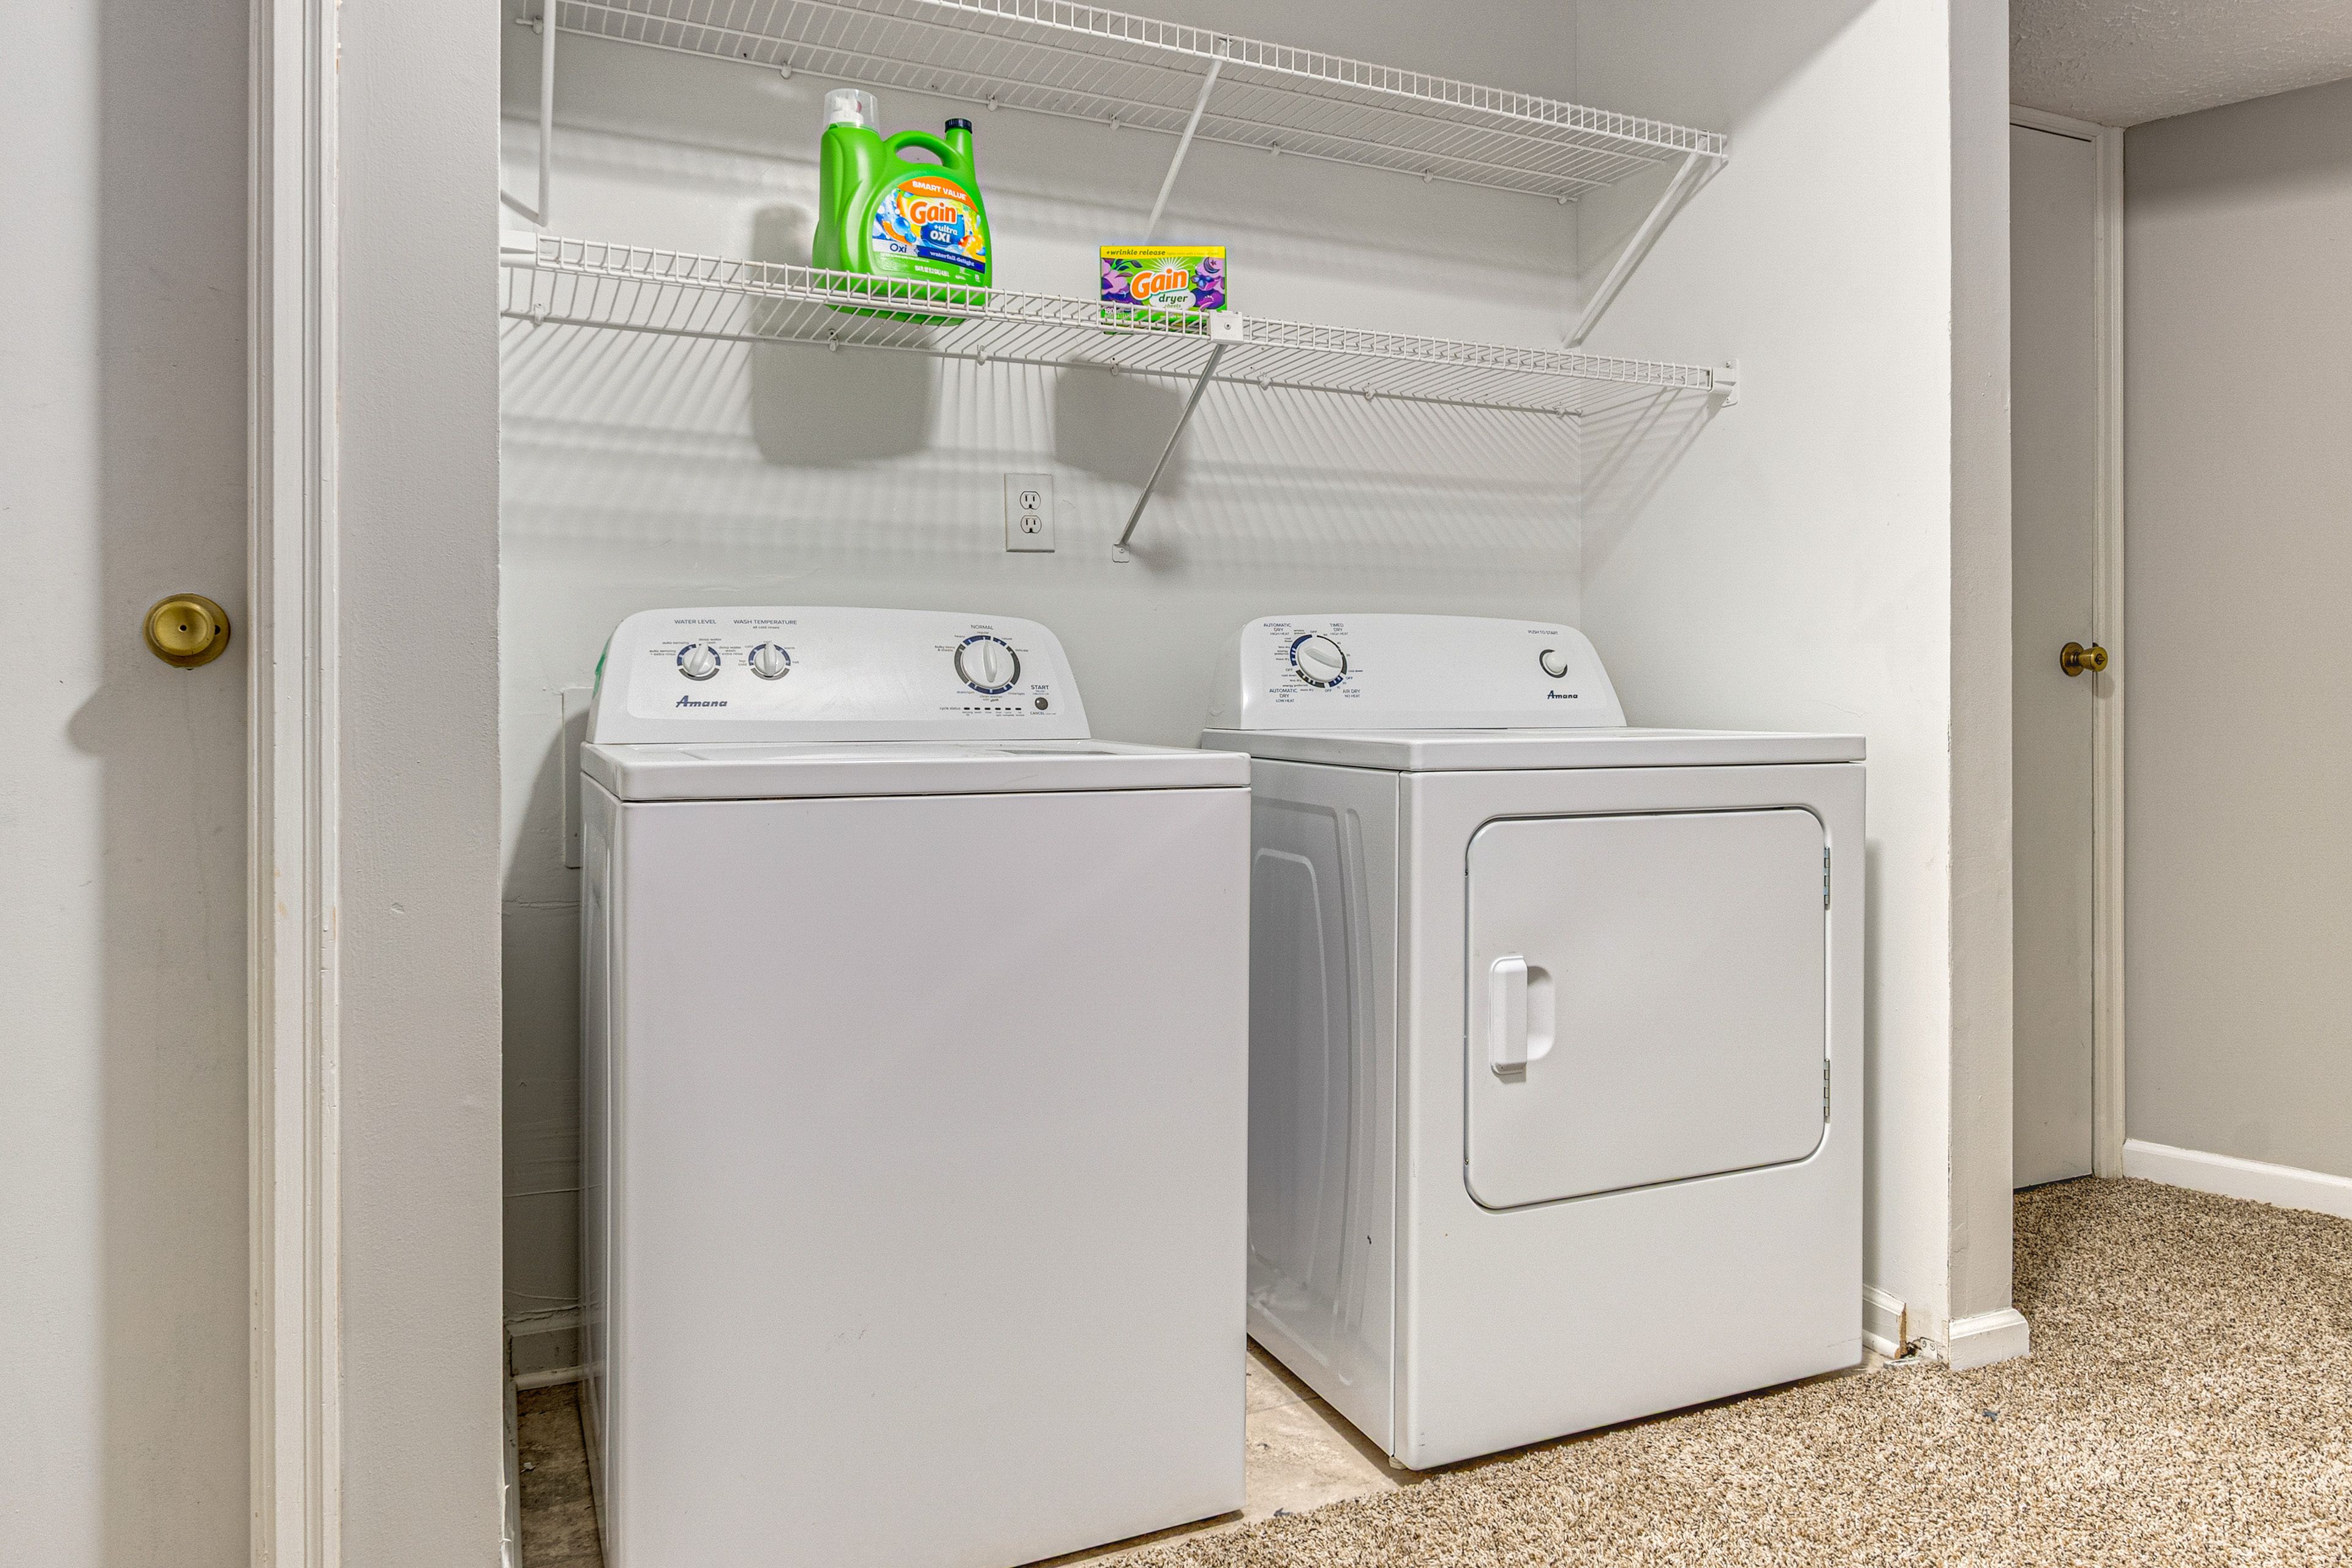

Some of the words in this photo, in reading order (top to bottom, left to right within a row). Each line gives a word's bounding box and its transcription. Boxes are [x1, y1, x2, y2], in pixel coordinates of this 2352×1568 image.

[913, 181, 941, 192] SMART
[943, 187, 967, 201] VALUE
[910, 202, 956, 224] Gain
[930, 230, 951, 243] OXI
[889, 243, 907, 253] Oxi
[930, 251, 956, 261] waterfall
[956, 257, 974, 266] delight
[1131, 268, 1187, 298] Gain
[1159, 294, 1188, 304] dryer
[676, 695, 728, 708] Amana
[1547, 690, 1578, 699] Amana
